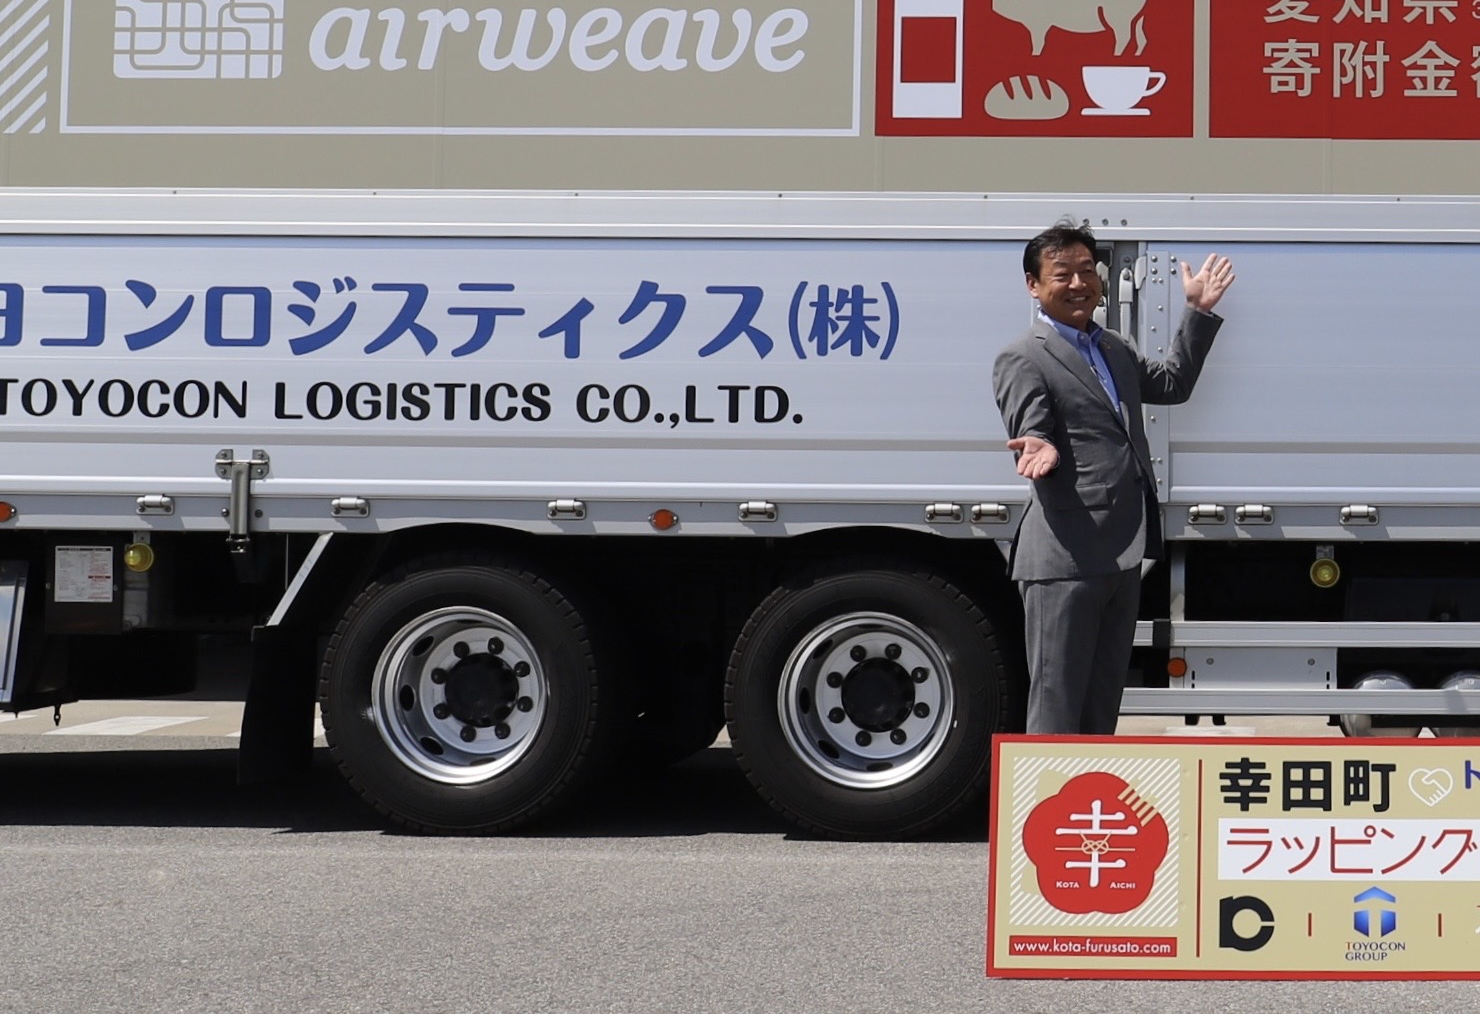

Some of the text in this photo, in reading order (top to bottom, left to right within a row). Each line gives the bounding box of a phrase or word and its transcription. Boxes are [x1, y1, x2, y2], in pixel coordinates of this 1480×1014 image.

[274, 382, 551, 423] LOGISTICS
[576, 383, 804, 428] CO.,LTD.
[1219, 757, 1396, 812] 幸田町
[1056, 881, 1136, 889] KOTA AICHI
[1014, 938, 1171, 954] www.kota-furusato.com
[1345, 942, 1406, 951] TOYOCON
[1345, 952, 1388, 961] GROUP
